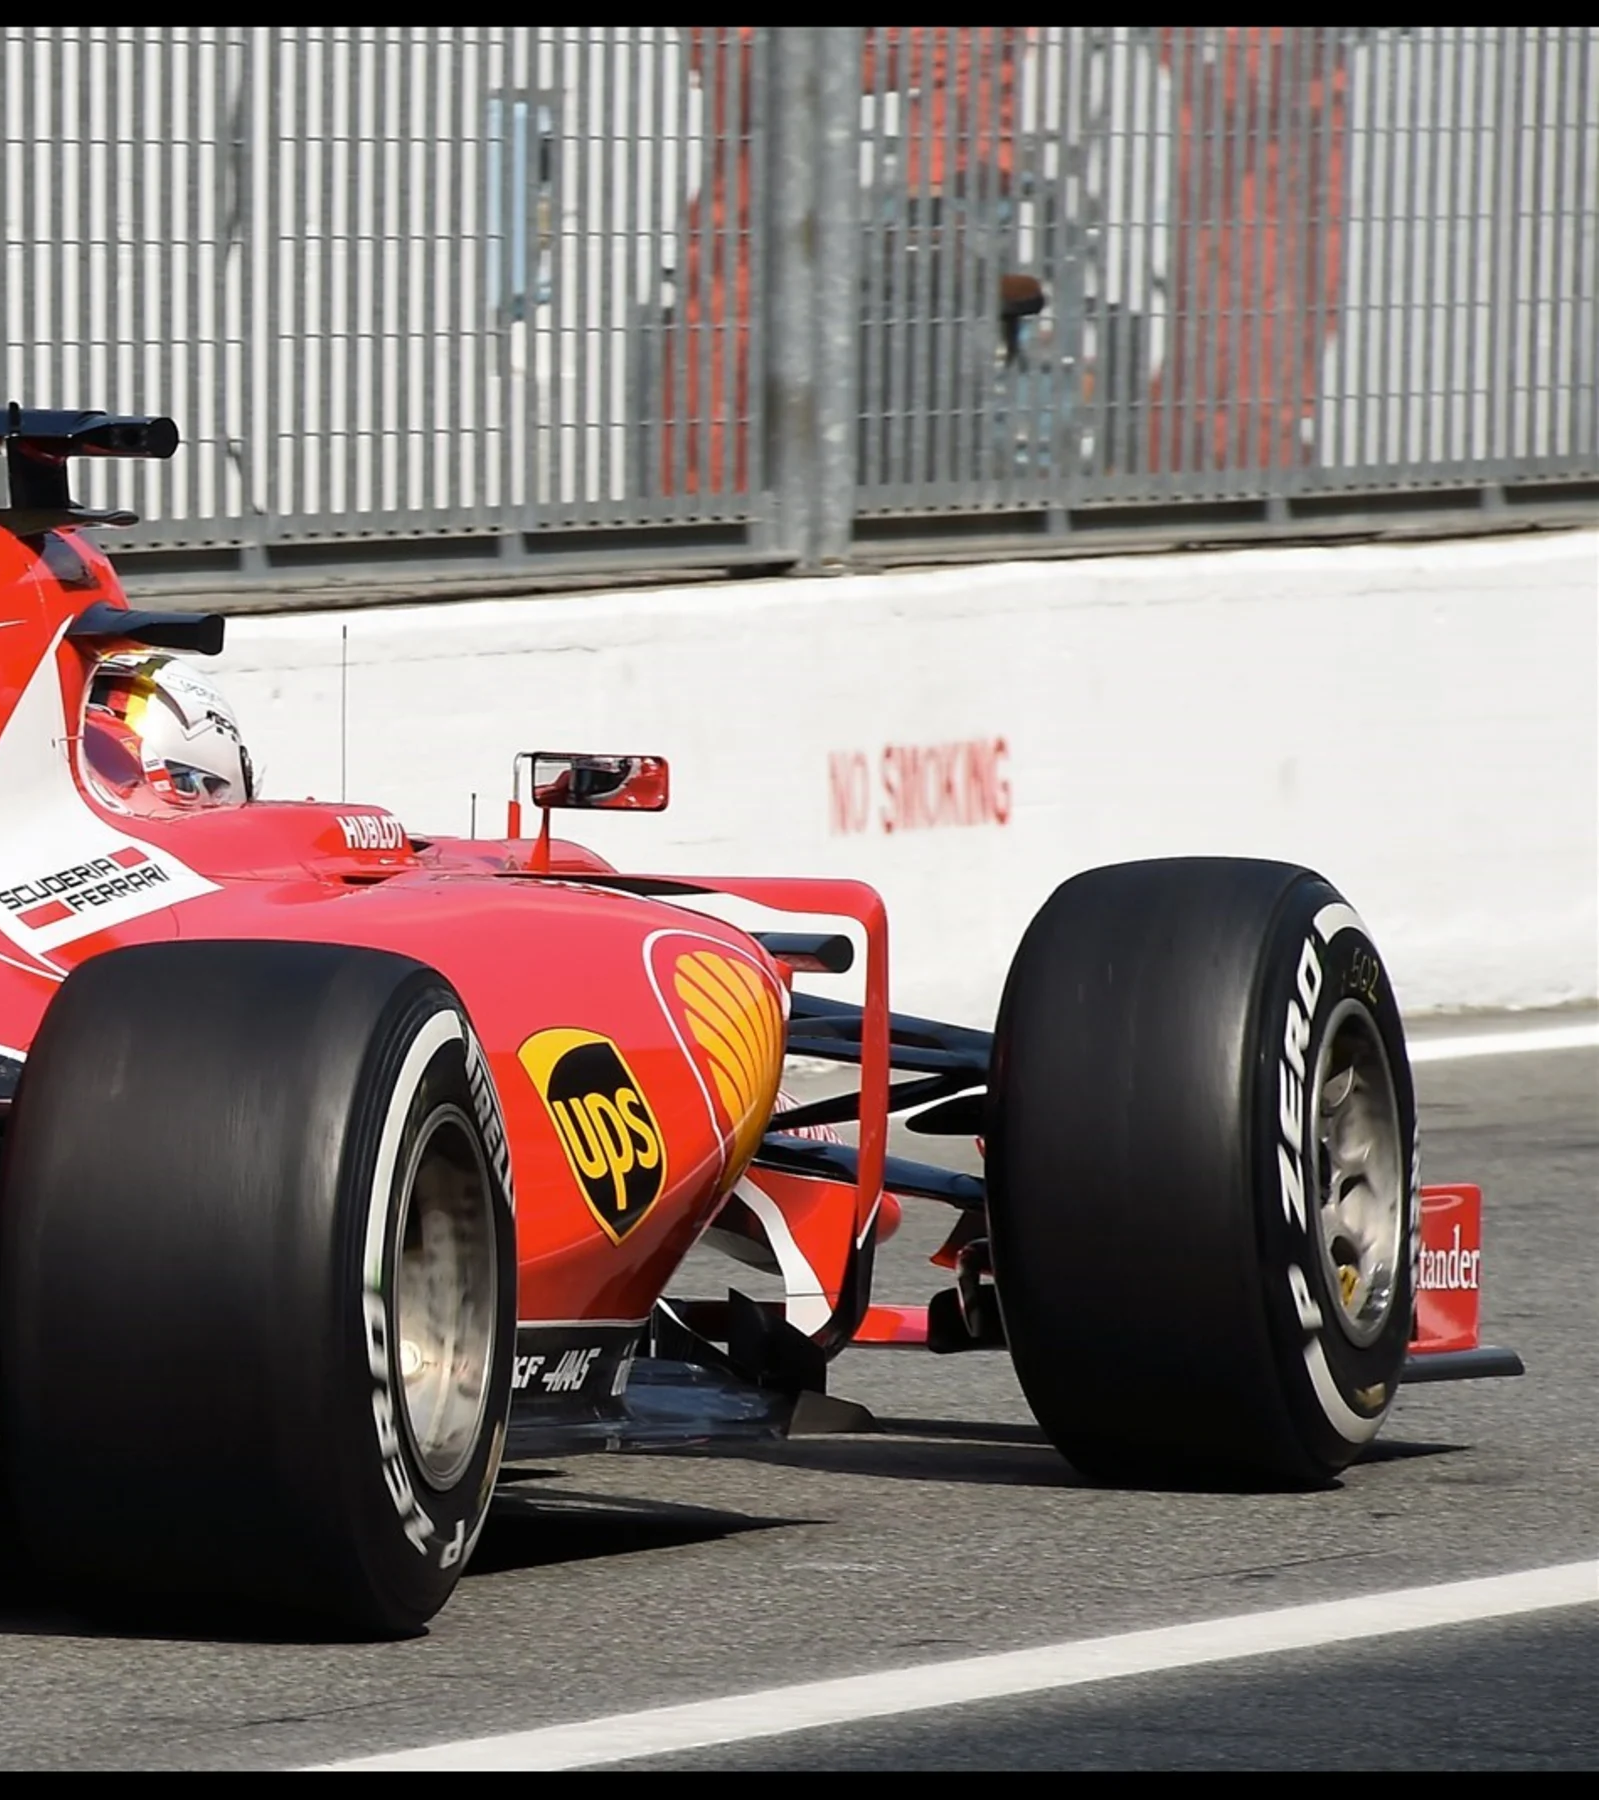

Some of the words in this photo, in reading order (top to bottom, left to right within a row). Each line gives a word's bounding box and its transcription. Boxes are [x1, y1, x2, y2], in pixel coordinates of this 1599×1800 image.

[828, 750, 870, 836] NO
[879, 738, 1012, 834] SMOKING
[335, 813, 404, 851] HUBLOT
[64, 863, 171, 913] FERRARI
[1277, 936, 1323, 1234] ZERO
[553, 1087, 658, 1211] ups
[1415, 1222, 1481, 1290] tander
[510, 1355, 546, 1389] KF
[362, 1290, 437, 1557] ZERO
